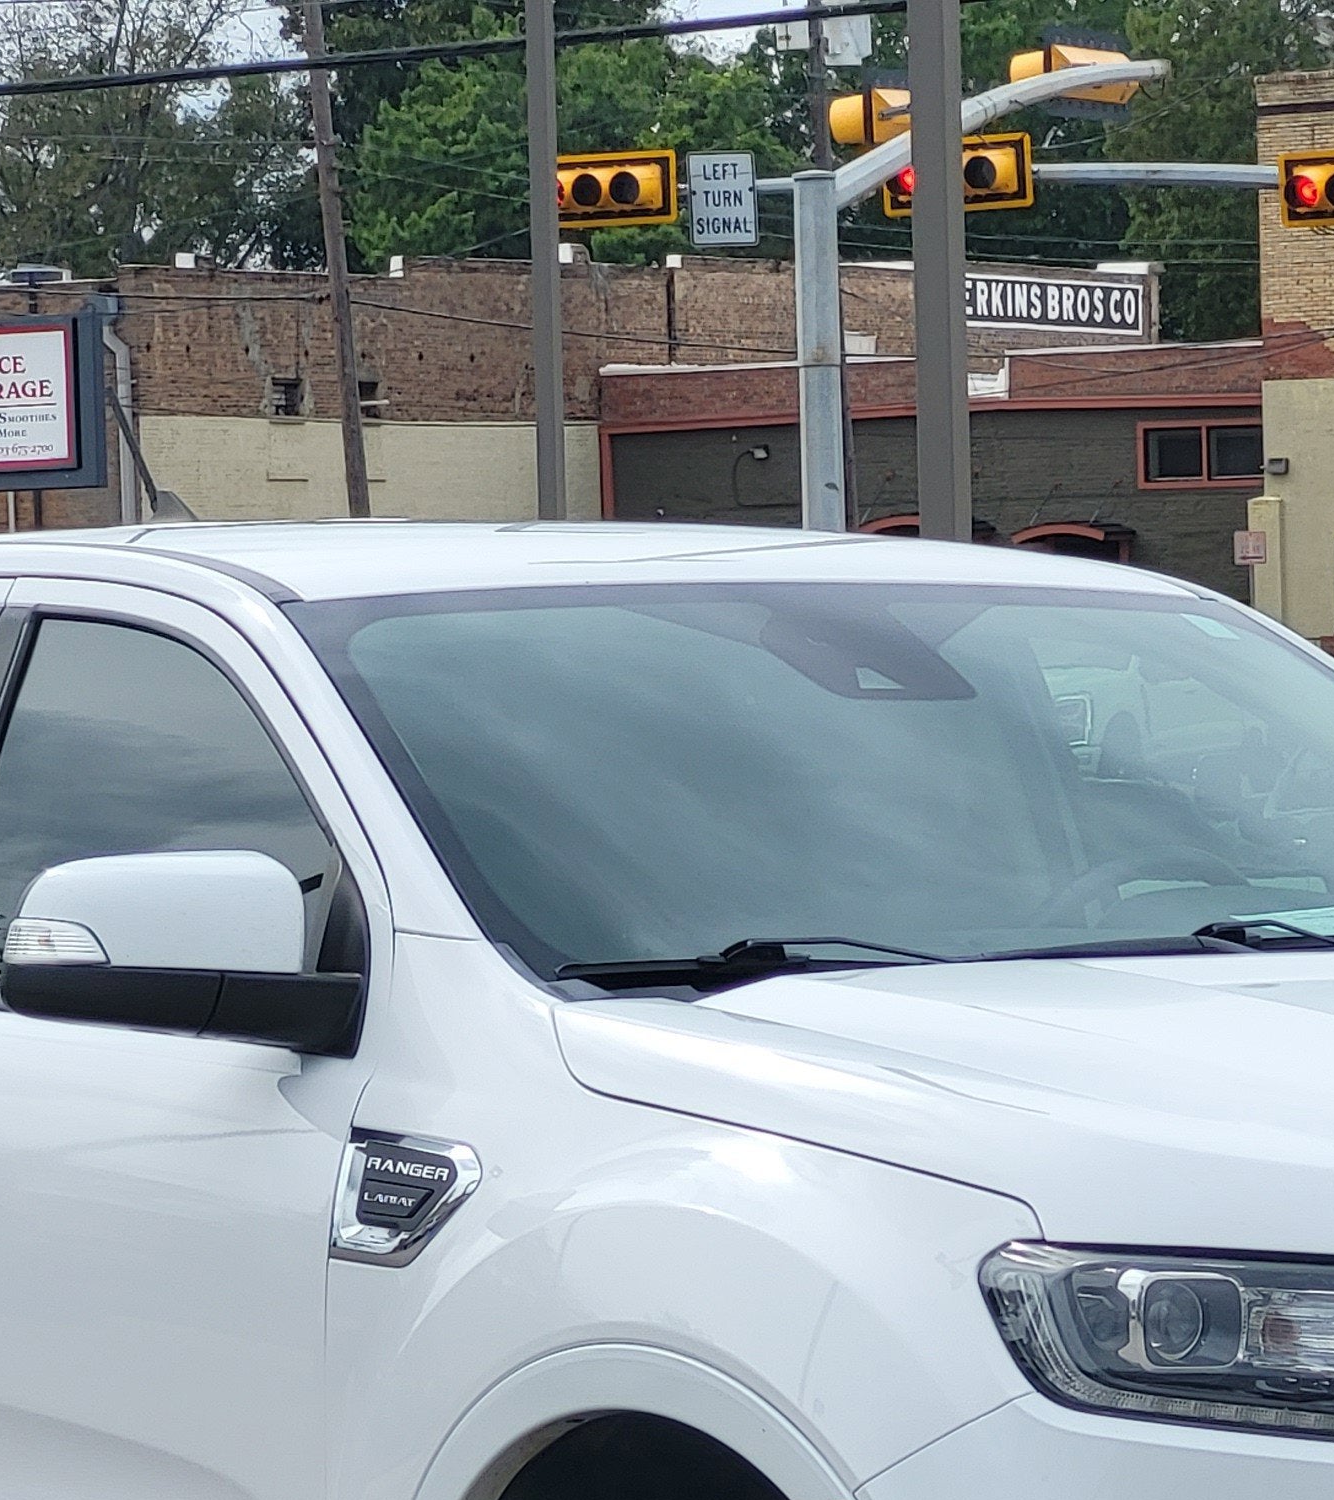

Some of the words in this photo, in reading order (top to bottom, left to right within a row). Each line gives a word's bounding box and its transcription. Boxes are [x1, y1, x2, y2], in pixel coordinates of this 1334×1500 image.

[703, 163, 739, 180] LEFT
[703, 190, 743, 207] TURN
[696, 216, 752, 235] SIGNAL
[1046, 284, 1105, 323] BROS
[1109, 289, 1136, 325] CO
[367, 1157, 449, 1181] RANGER
